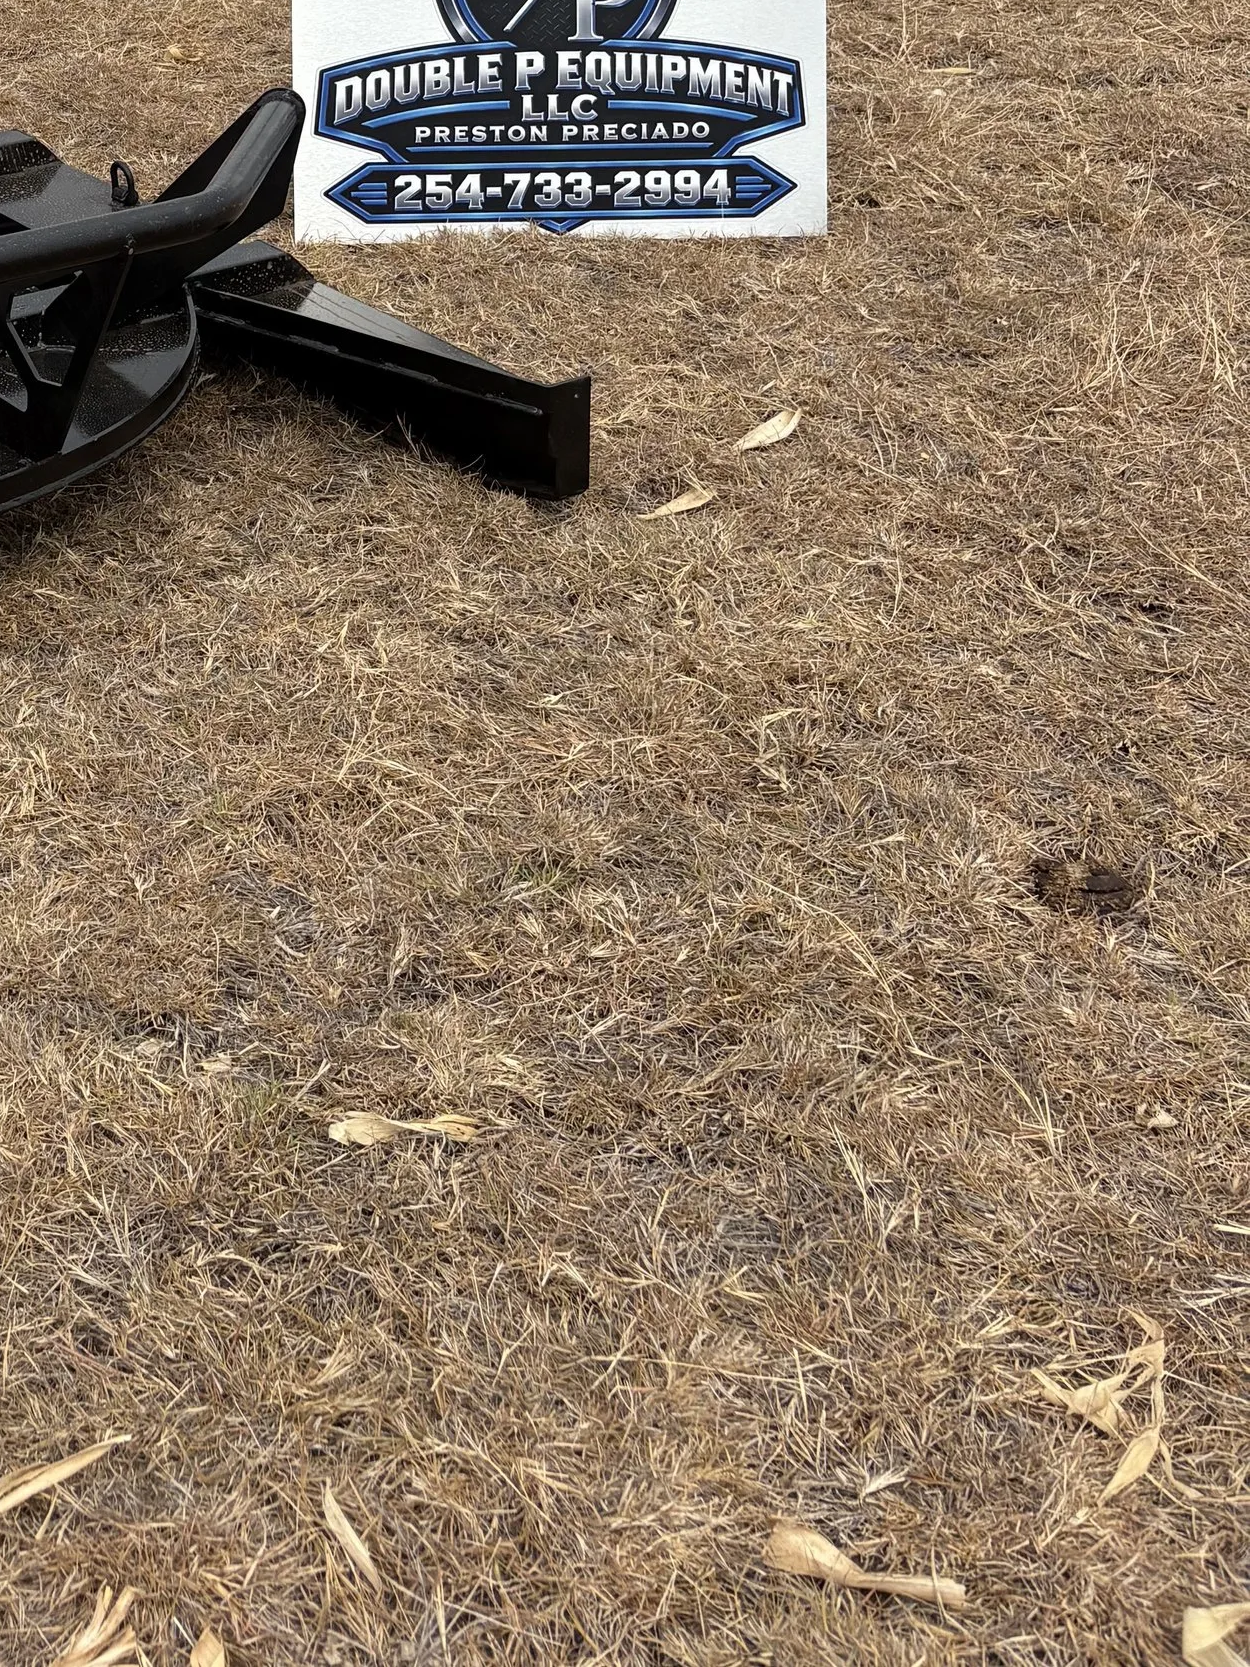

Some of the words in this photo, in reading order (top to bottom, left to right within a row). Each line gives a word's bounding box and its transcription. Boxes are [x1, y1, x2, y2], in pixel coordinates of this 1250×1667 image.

[333, 52, 504, 127] DOUBLE
[514, 50, 547, 92] P
[556, 50, 795, 118] EQUIPMENT
[521, 93, 599, 122] LLC
[414, 125, 548, 144] PRESTON
[561, 120, 711, 142] PRECIADO
[393, 168, 732, 212] 254-733-2994
